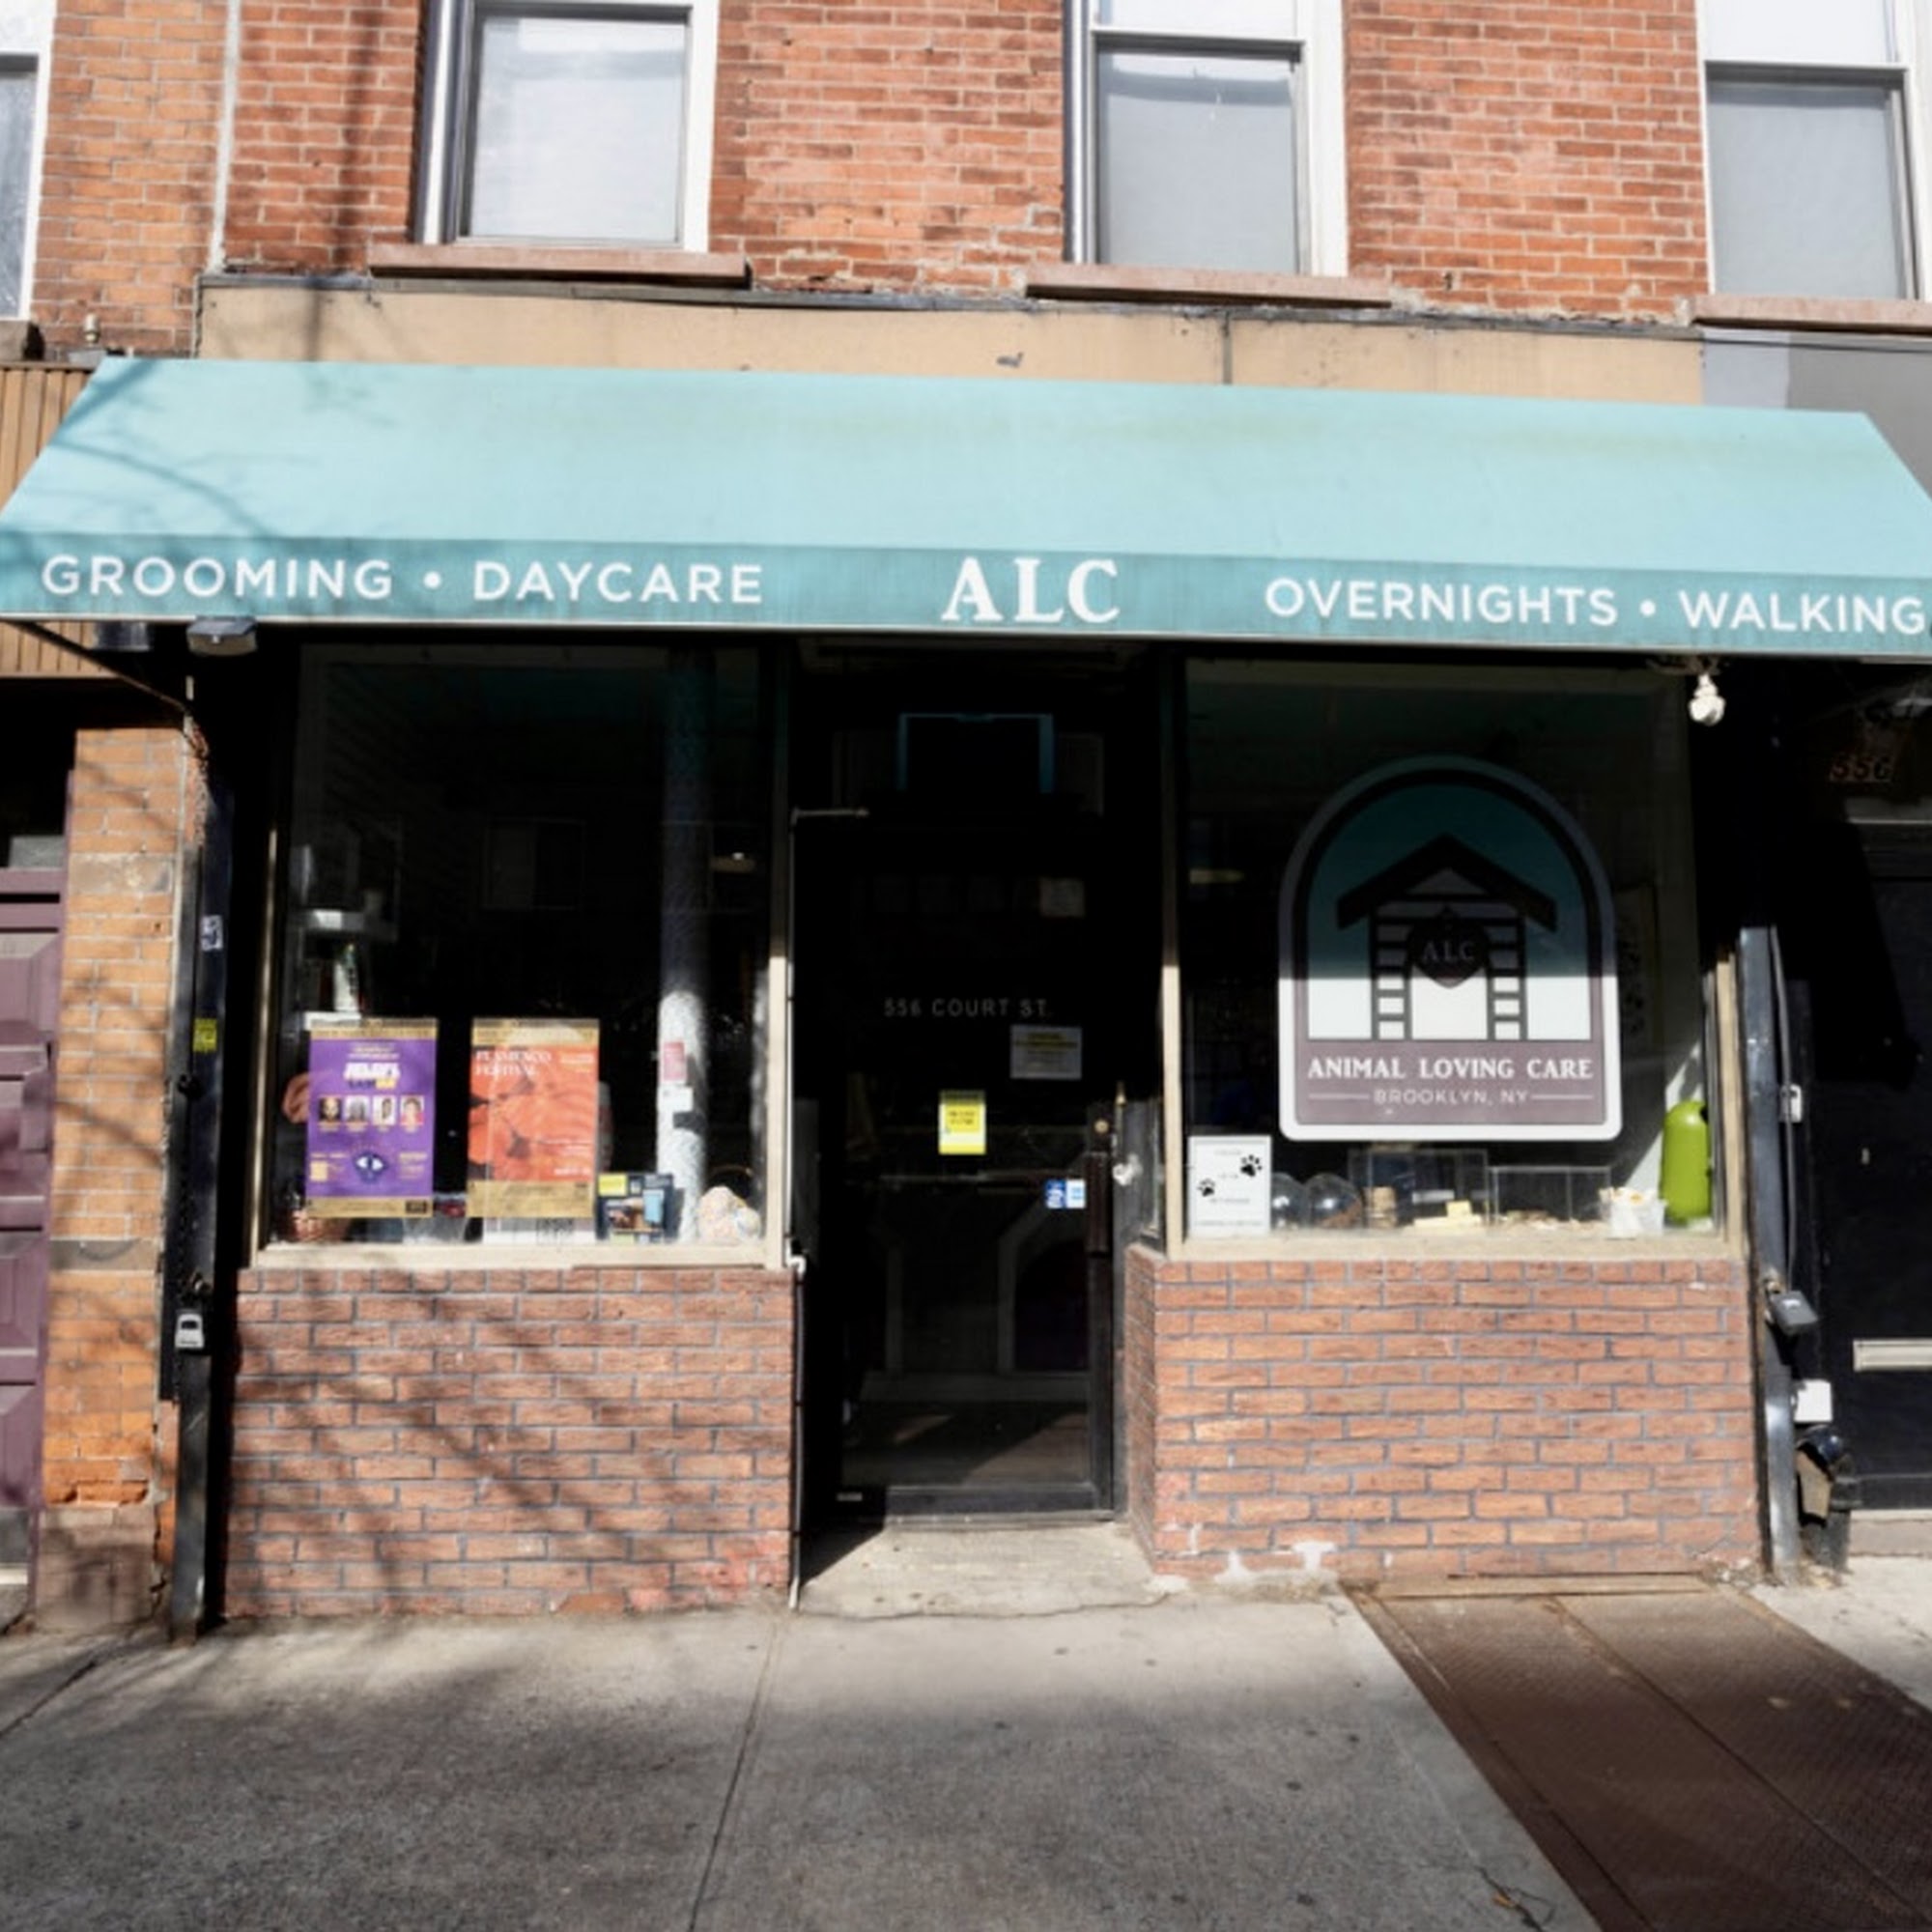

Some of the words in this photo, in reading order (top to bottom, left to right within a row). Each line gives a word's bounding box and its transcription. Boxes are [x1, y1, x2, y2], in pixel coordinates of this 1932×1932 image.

[41, 554, 392, 600] GROOMING
[472, 560, 763, 605] DAYCARE
[940, 556, 1121, 624] ALC
[1264, 577, 1618, 626] OVERNIGHTS
[1678, 589, 1925, 635] WALKING
[1422, 941, 1474, 963] ALC
[931, 998, 1009, 1016] COURT
[1308, 1057, 1406, 1080] ANIMAL
[1419, 1058, 1515, 1080] LOVING
[1526, 1059, 1593, 1080] CARE
[1374, 1089, 1492, 1106] BROOKLYN,
[1501, 1090, 1528, 1104] NY
